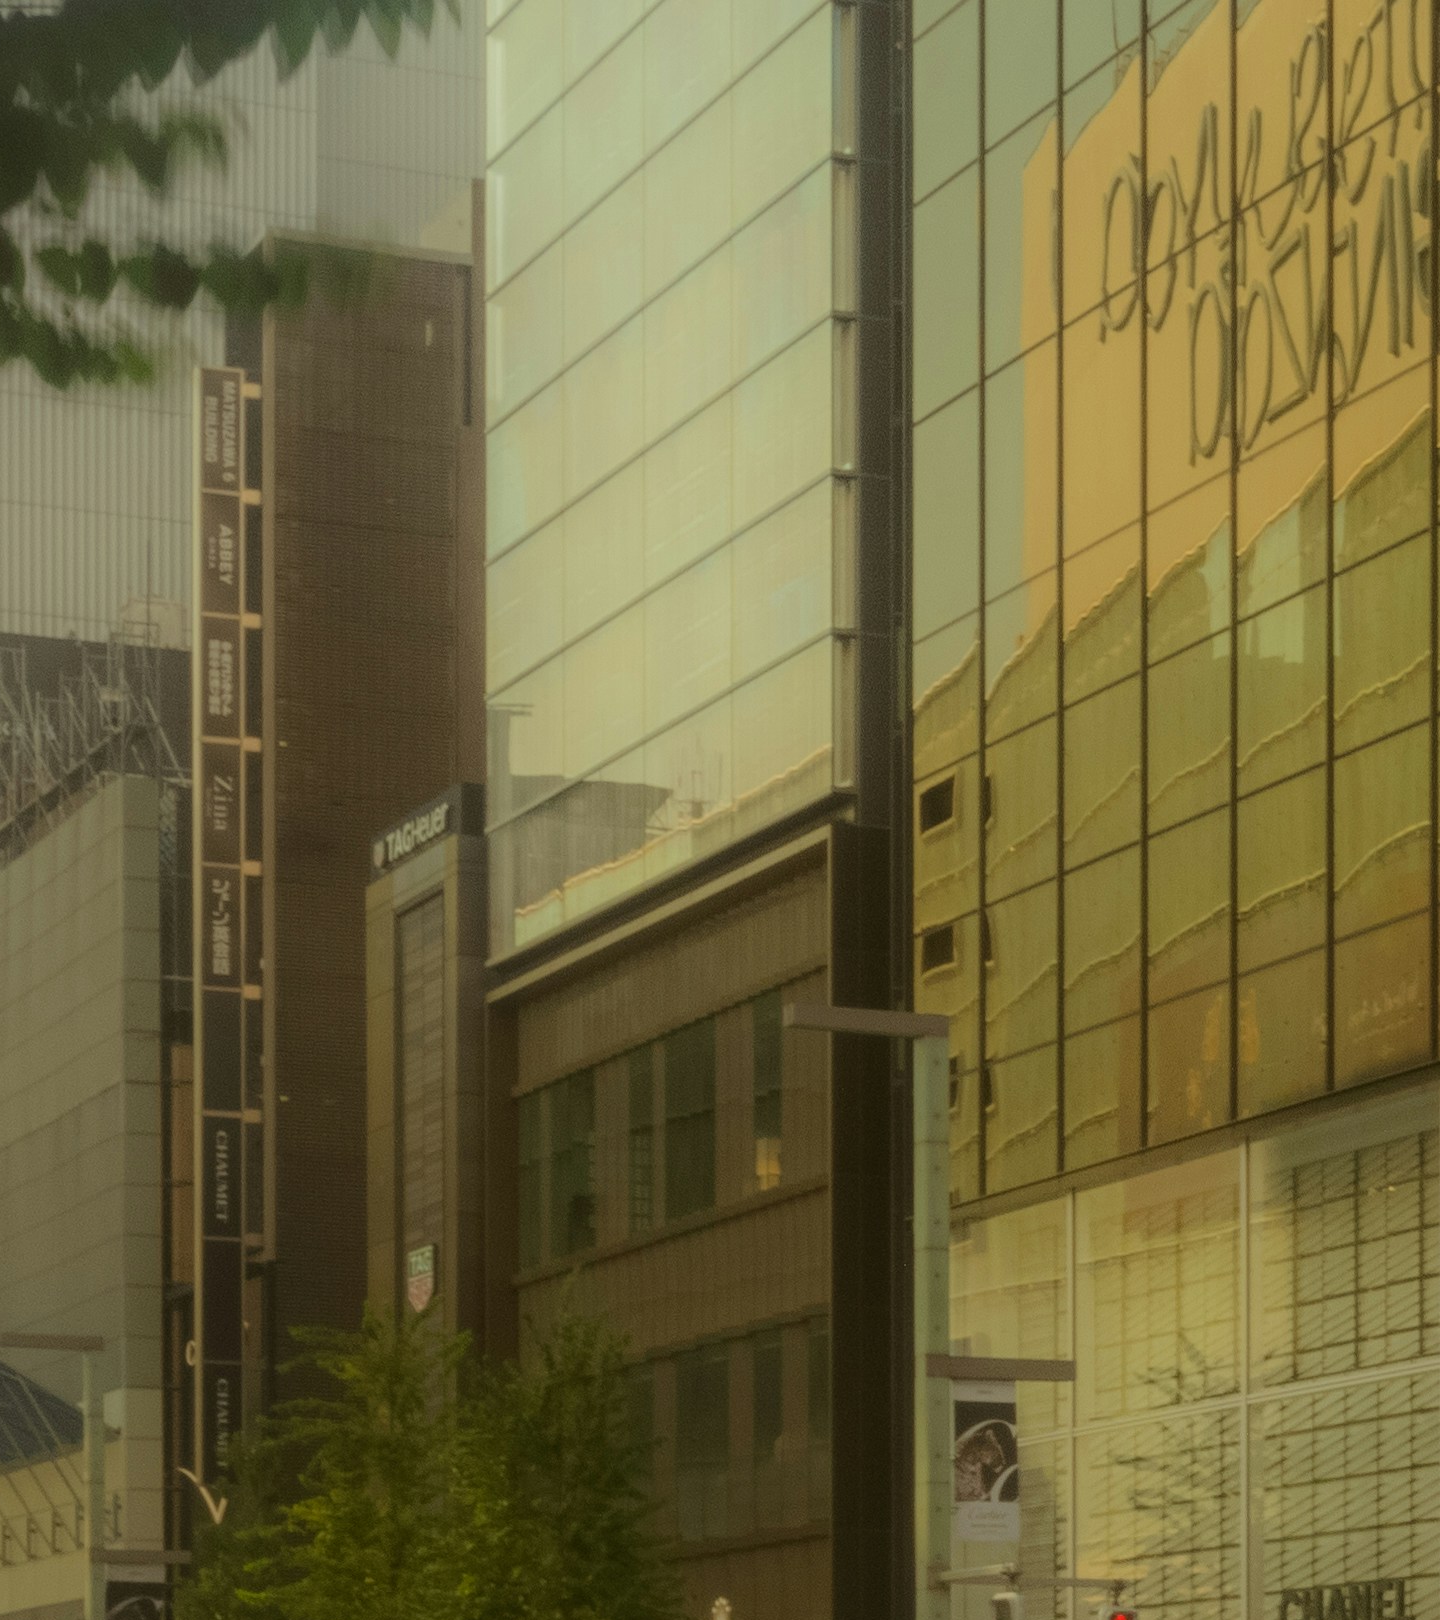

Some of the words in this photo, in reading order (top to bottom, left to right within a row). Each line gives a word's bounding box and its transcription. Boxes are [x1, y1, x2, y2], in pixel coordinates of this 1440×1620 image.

[205, 396, 218, 463] BUILDING
[222, 380, 236, 468] MATSUZAWA
[219, 524, 233, 586] ABBEY
[215, 1130, 229, 1224] CHAUMET
